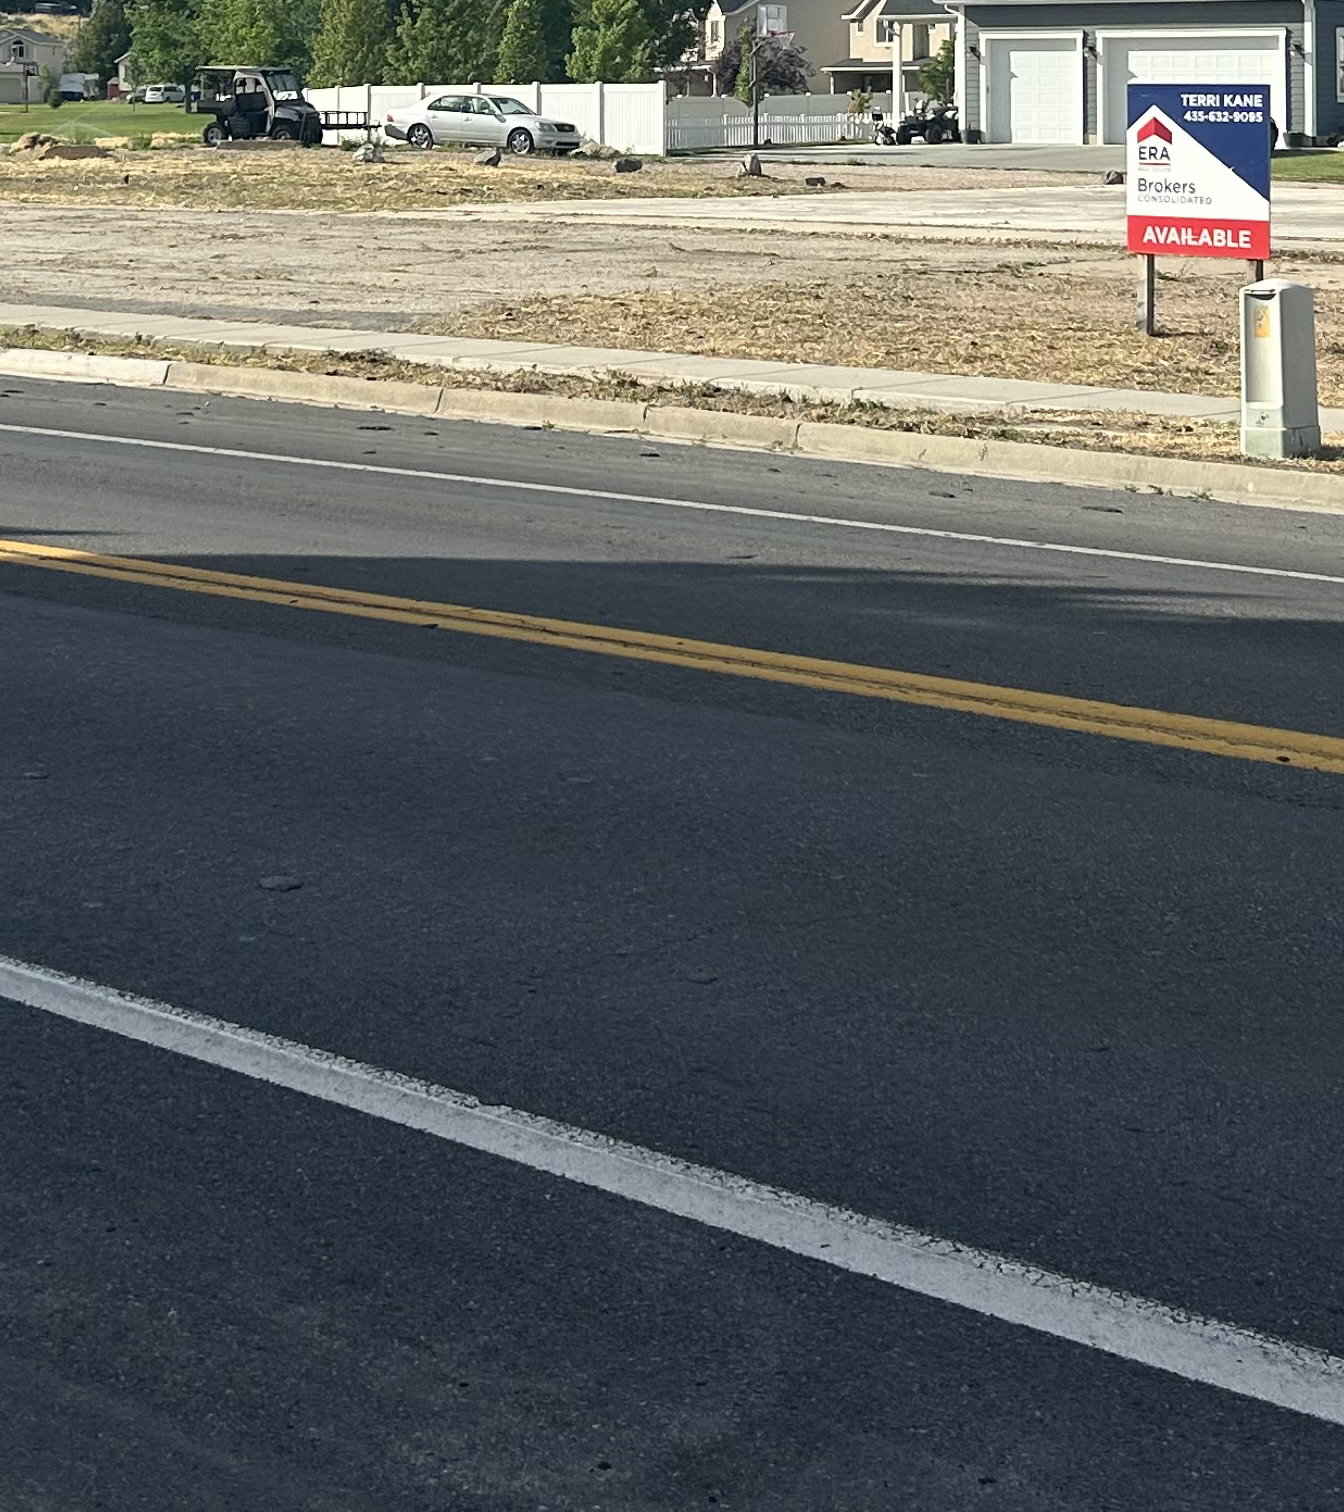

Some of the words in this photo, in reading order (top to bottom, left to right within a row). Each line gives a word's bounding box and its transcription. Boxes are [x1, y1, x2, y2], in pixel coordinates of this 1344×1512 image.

[1180, 94, 1220, 107] TERRI
[1223, 94, 1263, 107] KANE
[1183, 110, 1263, 123] 435-632-9095
[1138, 146, 1171, 161] ERA
[1137, 177, 1196, 194] Brokers
[1137, 194, 1213, 206] CONSOLIDATED
[1142, 225, 1252, 249] AVAILABLE
